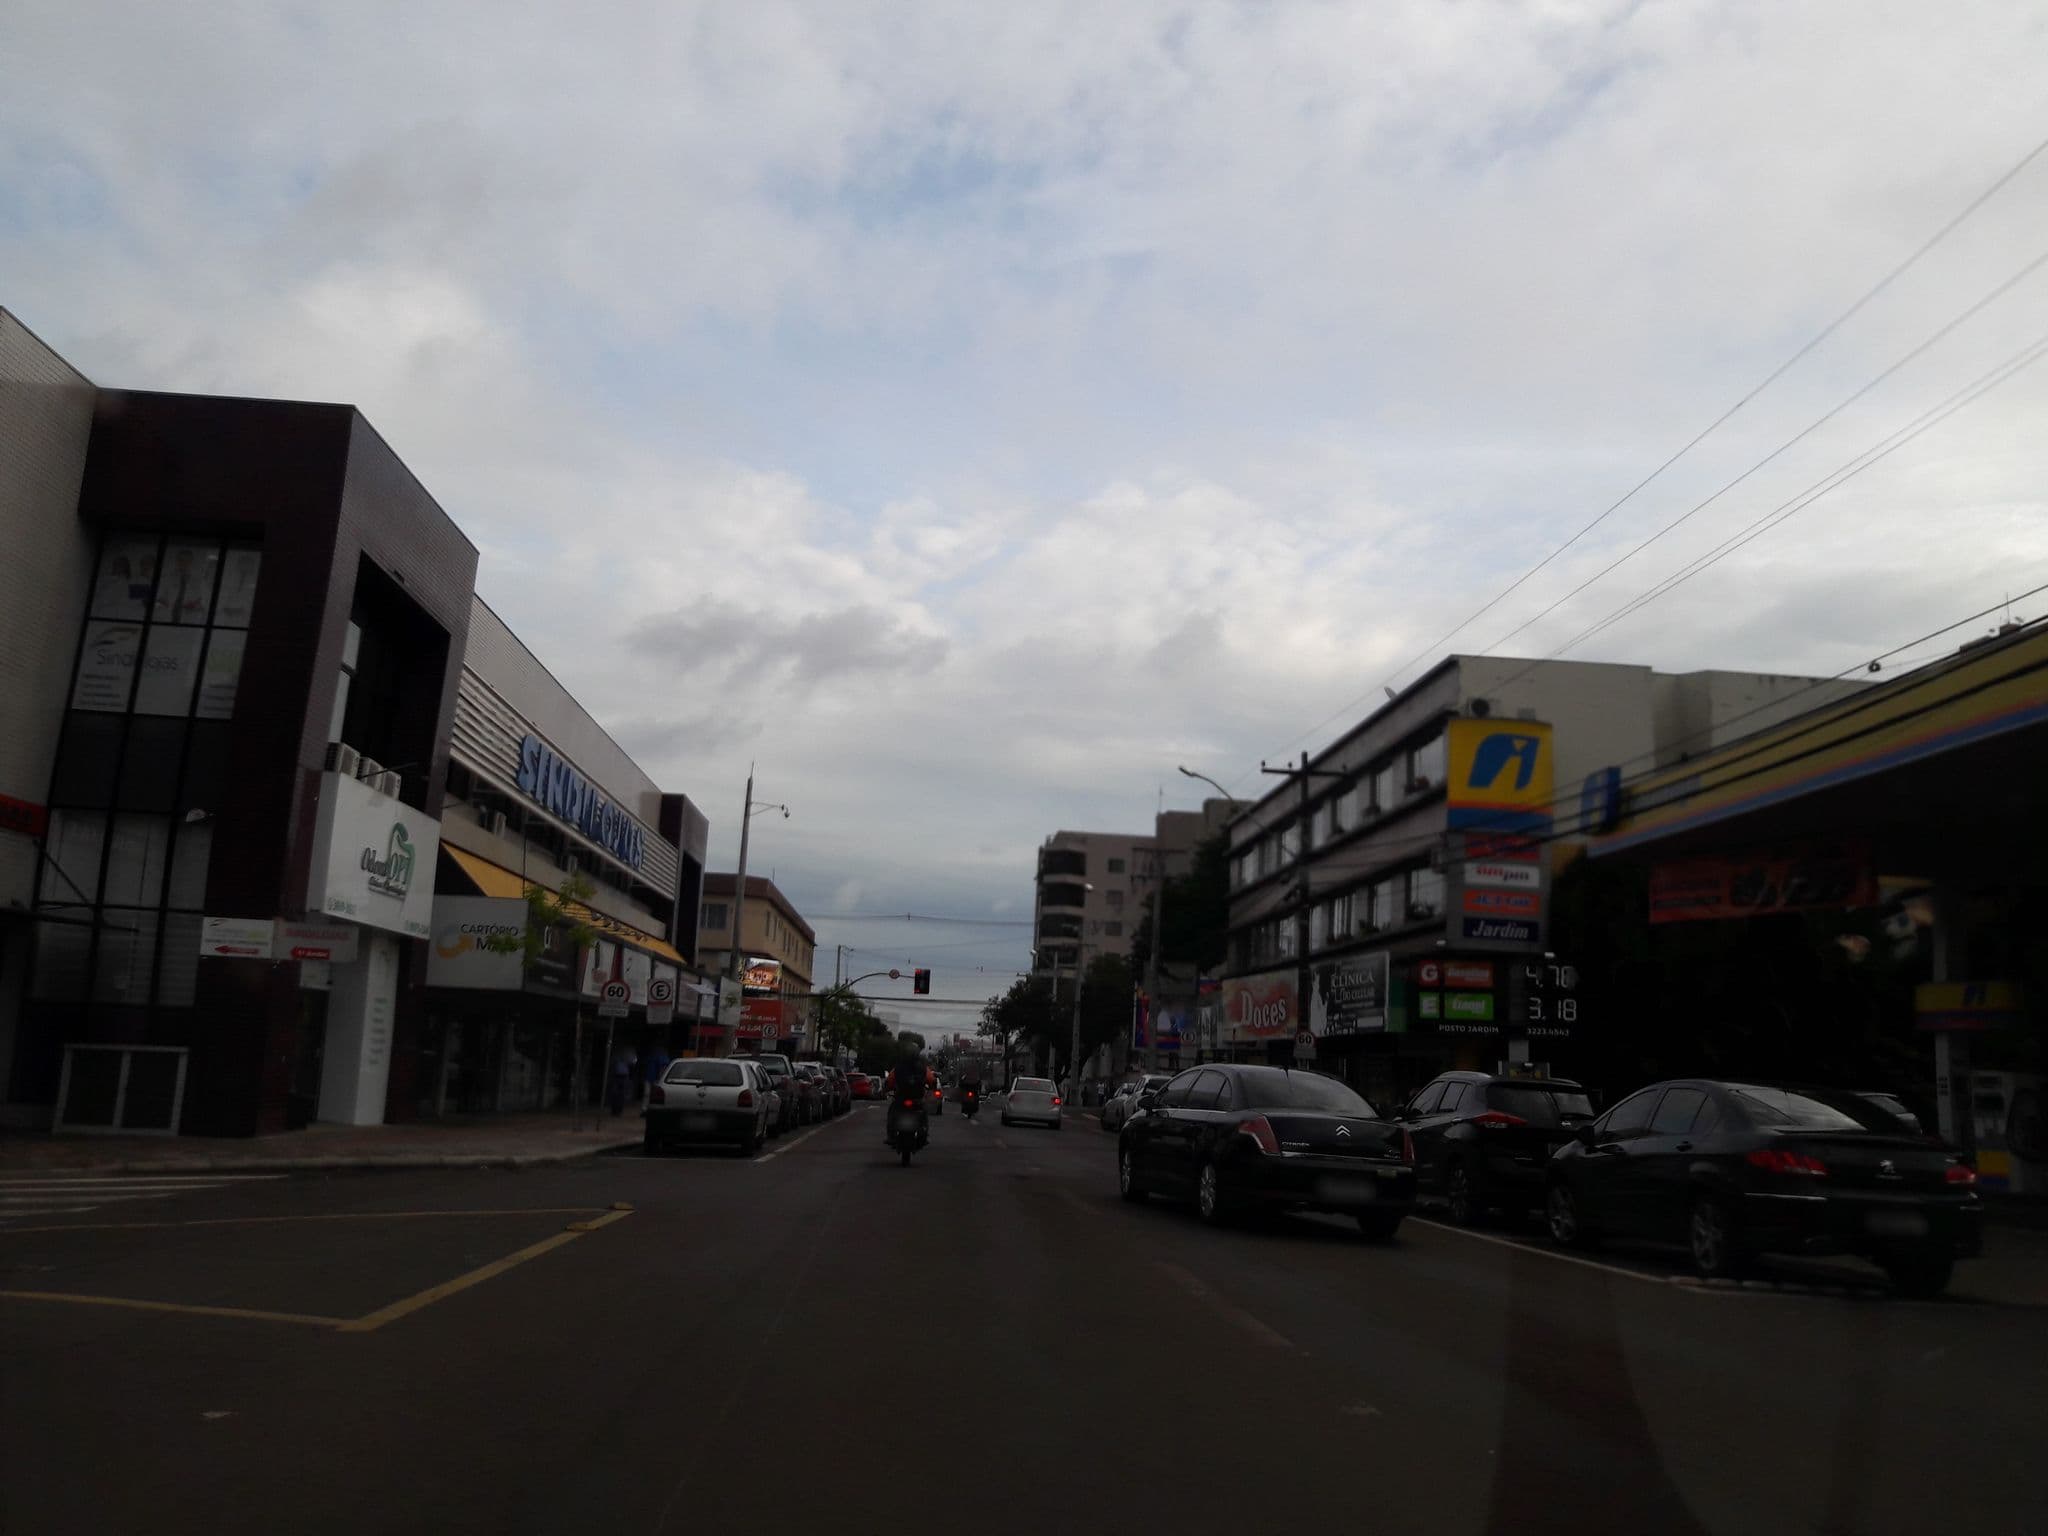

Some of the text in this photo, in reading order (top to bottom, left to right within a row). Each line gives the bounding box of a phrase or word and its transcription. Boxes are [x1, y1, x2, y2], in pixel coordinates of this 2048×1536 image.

[1471, 919, 1530, 940] Jardim
[1421, 963, 1438, 981] G
[607, 985, 625, 998] 60
[656, 984, 666, 998] E
[1241, 989, 1287, 1029] Doces
[1528, 996, 1577, 1022] 3.18
[1438, 1024, 1499, 1034] POSTO JARDIM
